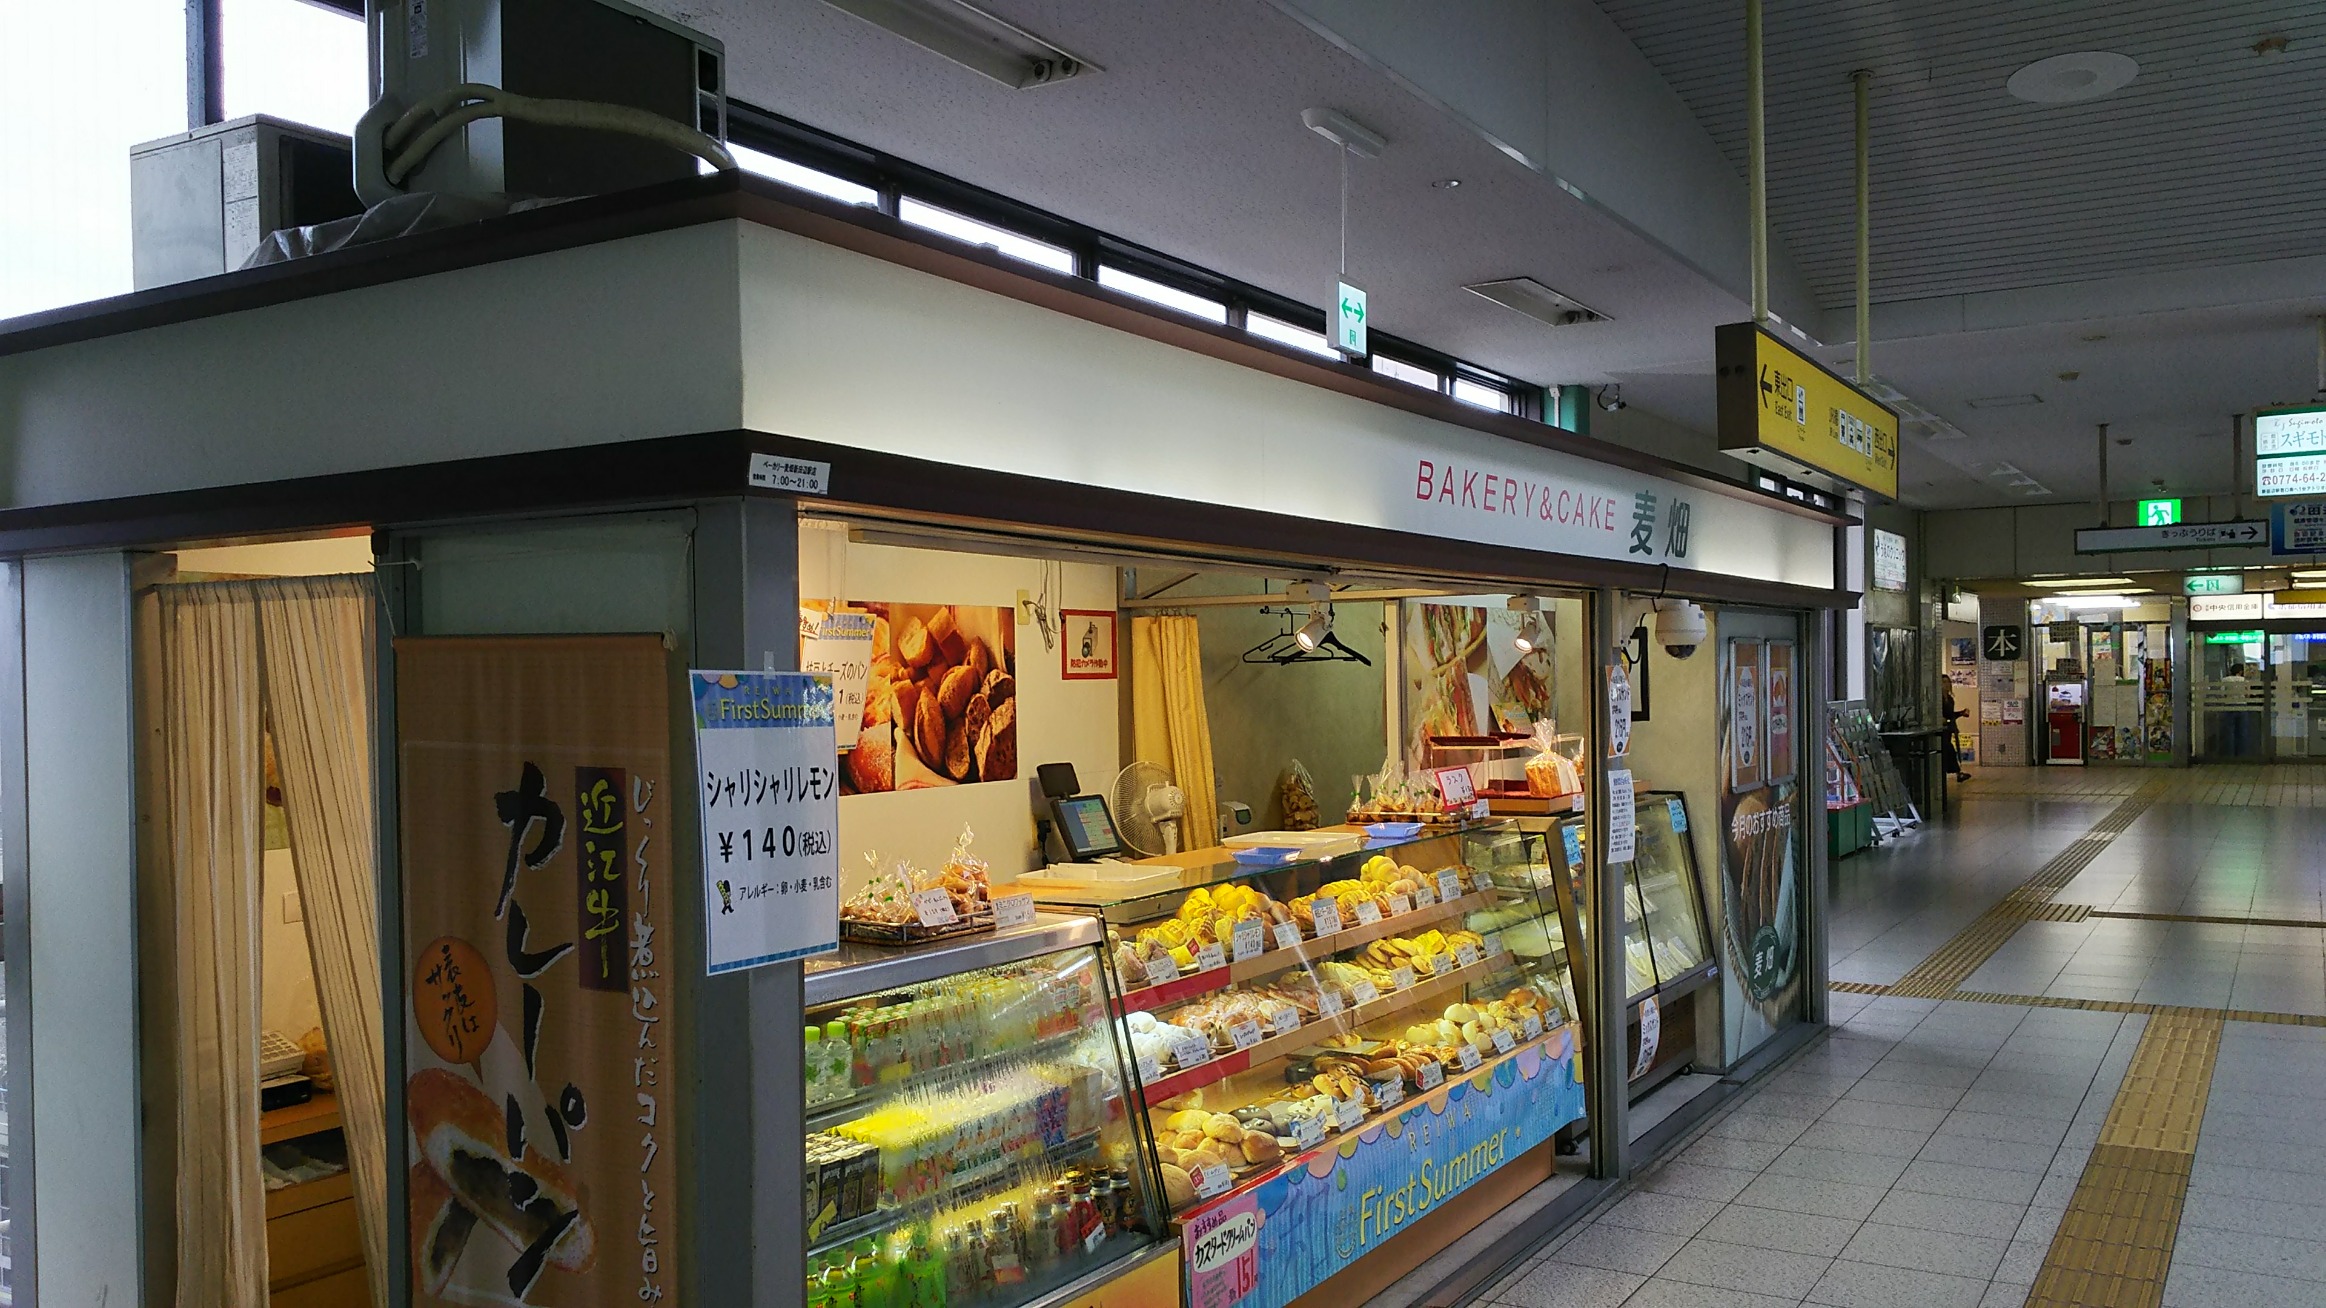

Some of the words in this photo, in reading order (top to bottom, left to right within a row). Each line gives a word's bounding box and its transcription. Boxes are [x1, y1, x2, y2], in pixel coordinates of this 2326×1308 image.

[1416, 460, 1616, 531] BAKERY&CAKE
[1629, 490, 1690, 558] 麦畑
[2161, 527, 2216, 539] きっぷうりば
[1987, 629, 2019, 657] 本
[707, 766, 835, 808] シャリシャリレモン
[1731, 803, 1791, 842] 今月のおすすめ商品
[580, 777, 625, 980] 近江牛
[1407, 1102, 1473, 1155] REIWA
[1194, 1209, 1228, 1240] おすすめ品
[1195, 1217, 1256, 1269] カスタードクリームパン
